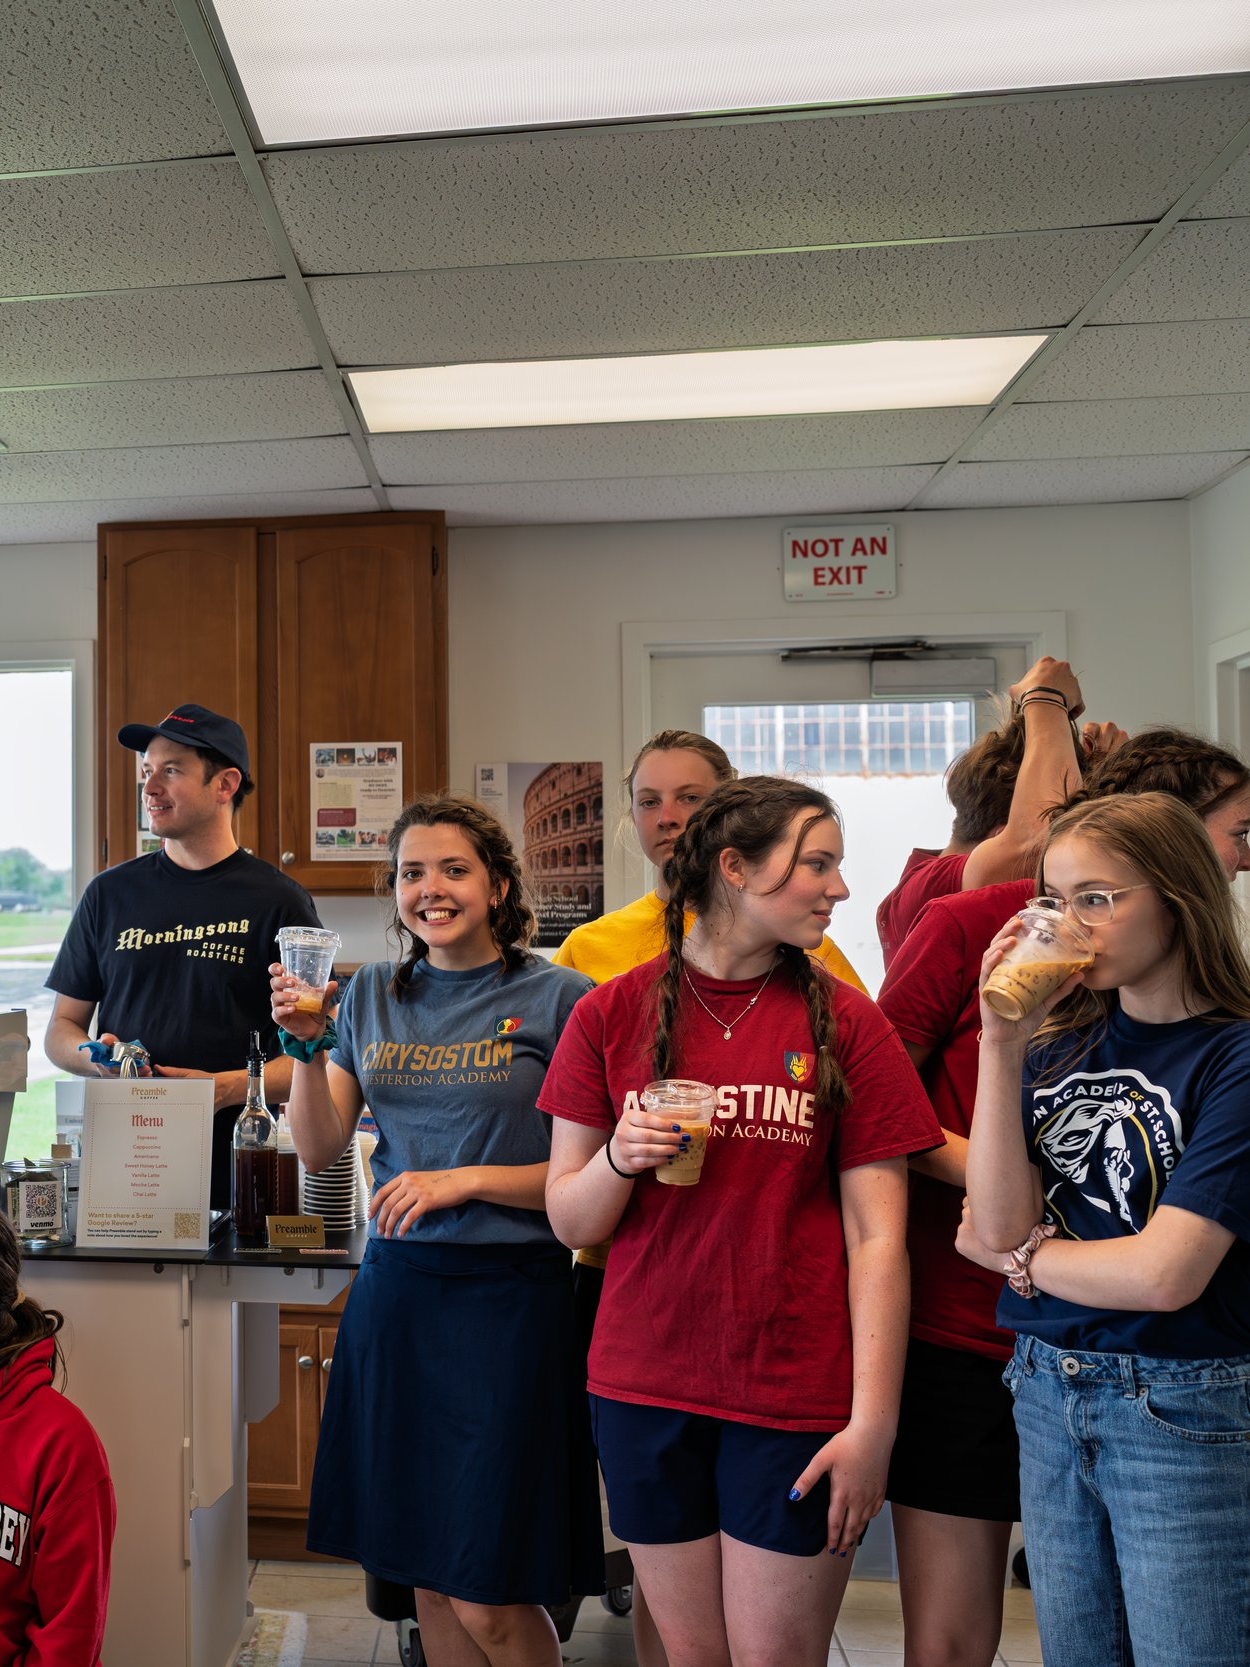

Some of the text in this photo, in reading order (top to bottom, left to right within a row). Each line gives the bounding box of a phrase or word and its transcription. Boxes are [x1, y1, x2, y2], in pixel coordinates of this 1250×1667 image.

[792, 536, 887, 559] NOT AN
[813, 565, 867, 587] EXIT
[553, 894, 579, 903] School
[554, 904, 575, 912] Study
[576, 903, 592, 911] and
[551, 911, 588, 920] Programs
[115, 919, 250, 951] Morningsong
[203, 942, 246, 956] COFFEE
[186, 949, 244, 964] ROASTERS
[362, 1039, 513, 1072] CHRYSOSTOM
[131, 1087, 167, 1096] Preamble
[1129, 1090, 1145, 1102] OF
[131, 1114, 164, 1127] Menu
[30, 1220, 54, 1229] venmo
[275, 1224, 318, 1234] Preamble
